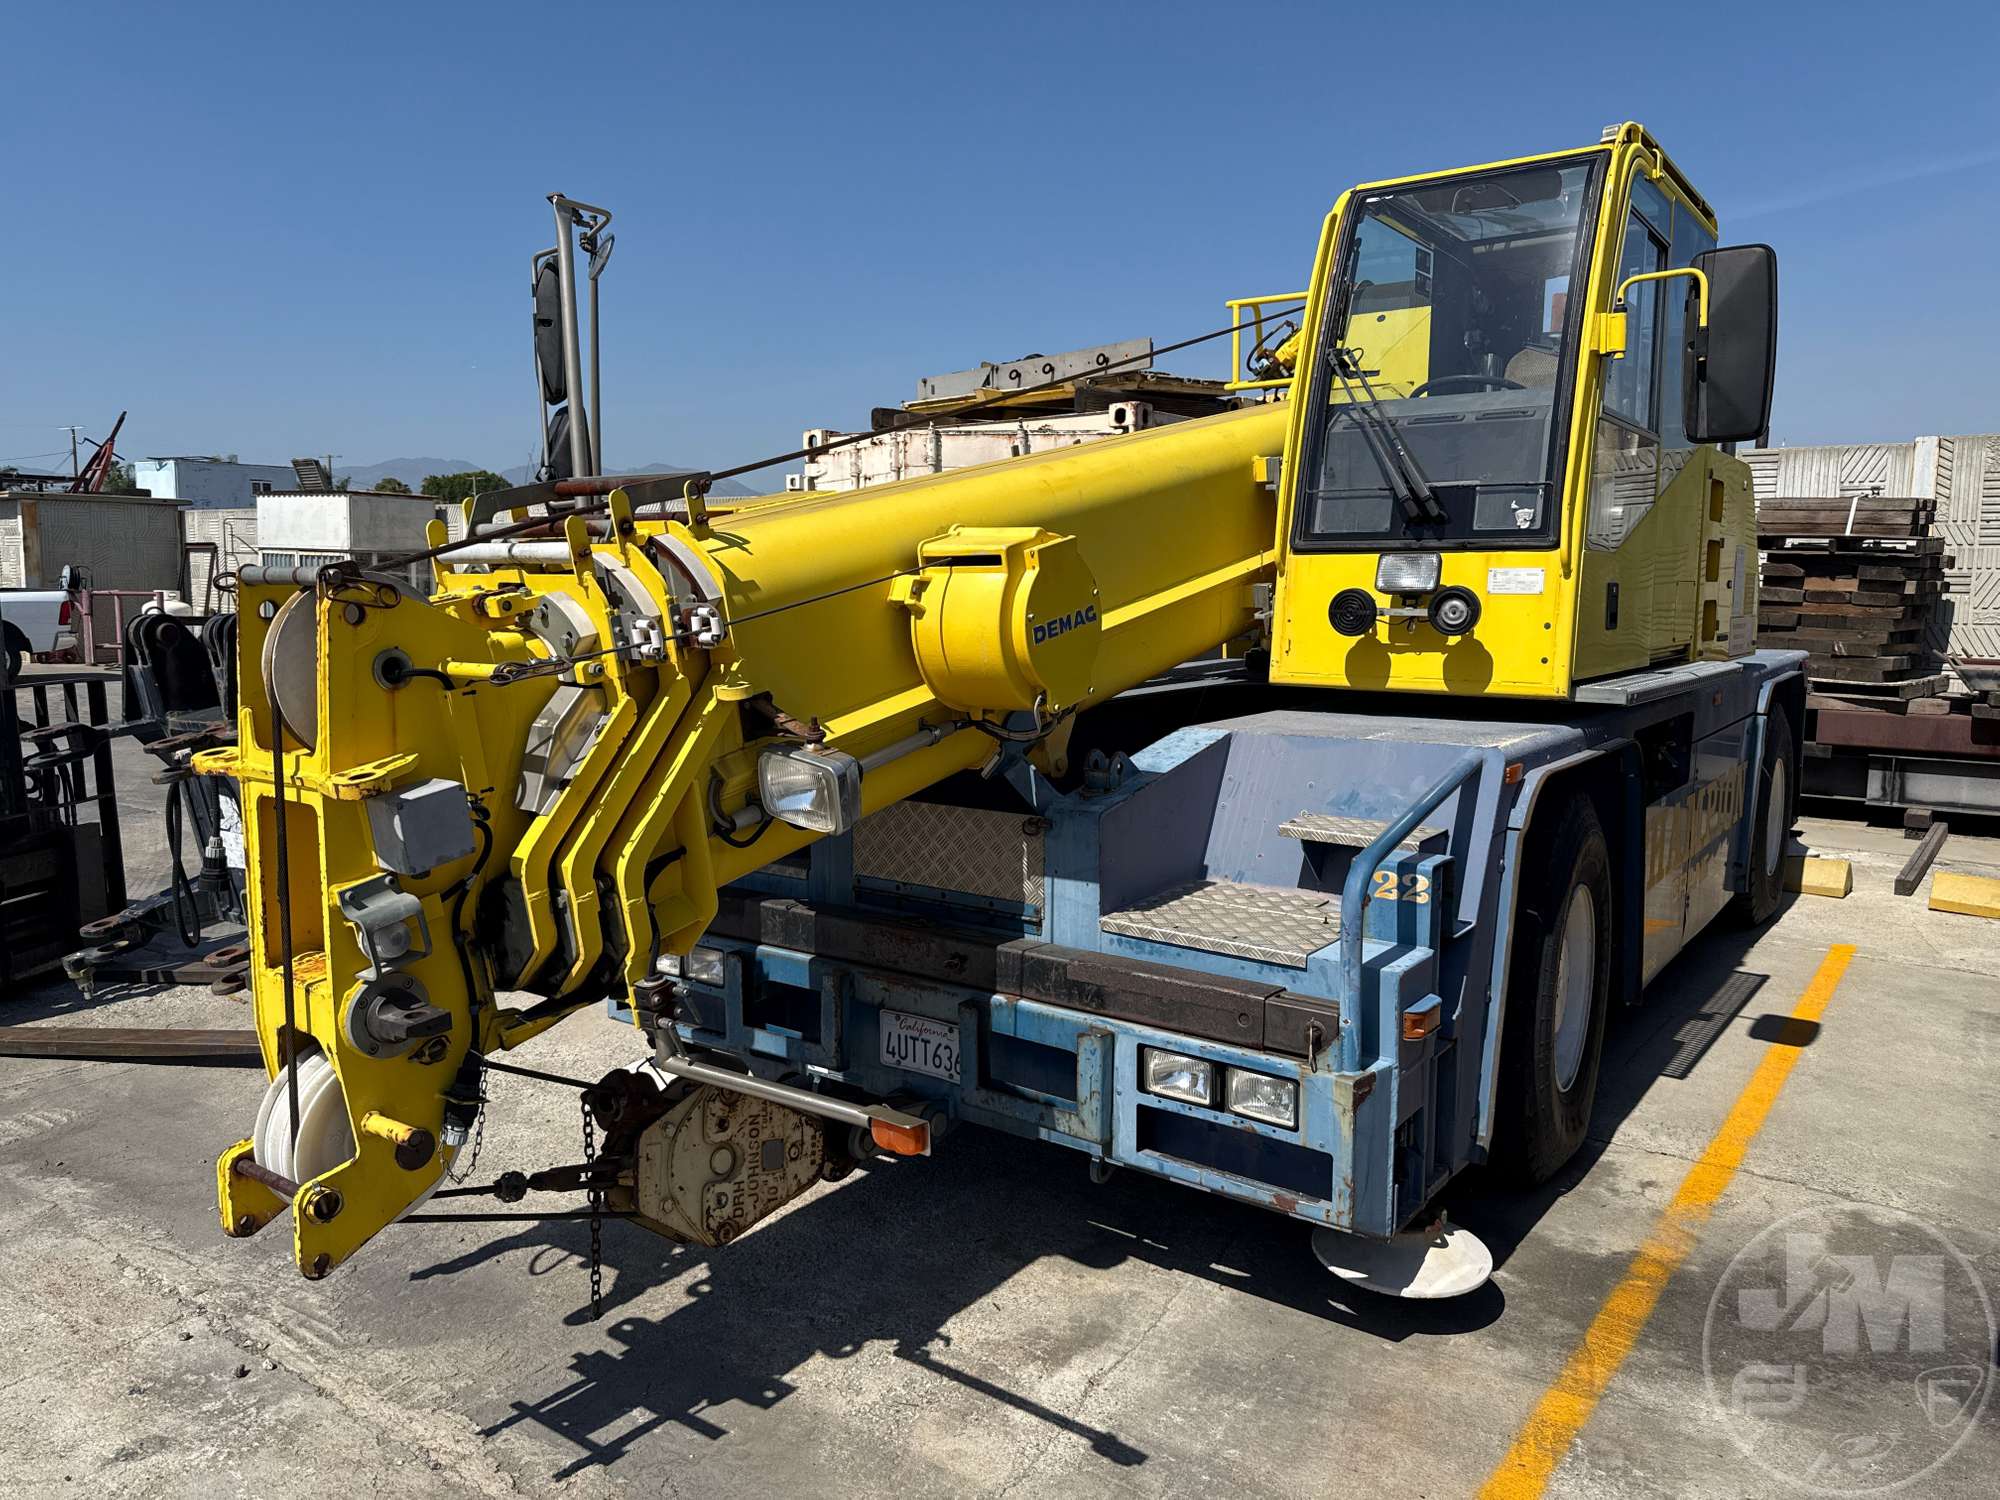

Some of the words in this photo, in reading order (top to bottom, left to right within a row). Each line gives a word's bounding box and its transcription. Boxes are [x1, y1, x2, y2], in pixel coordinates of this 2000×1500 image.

[1032, 603, 1098, 647] DEMAG
[1372, 870, 1430, 905] 22
[899, 1018, 951, 1039] California
[747, 1113, 760, 1204] JOHNSON
